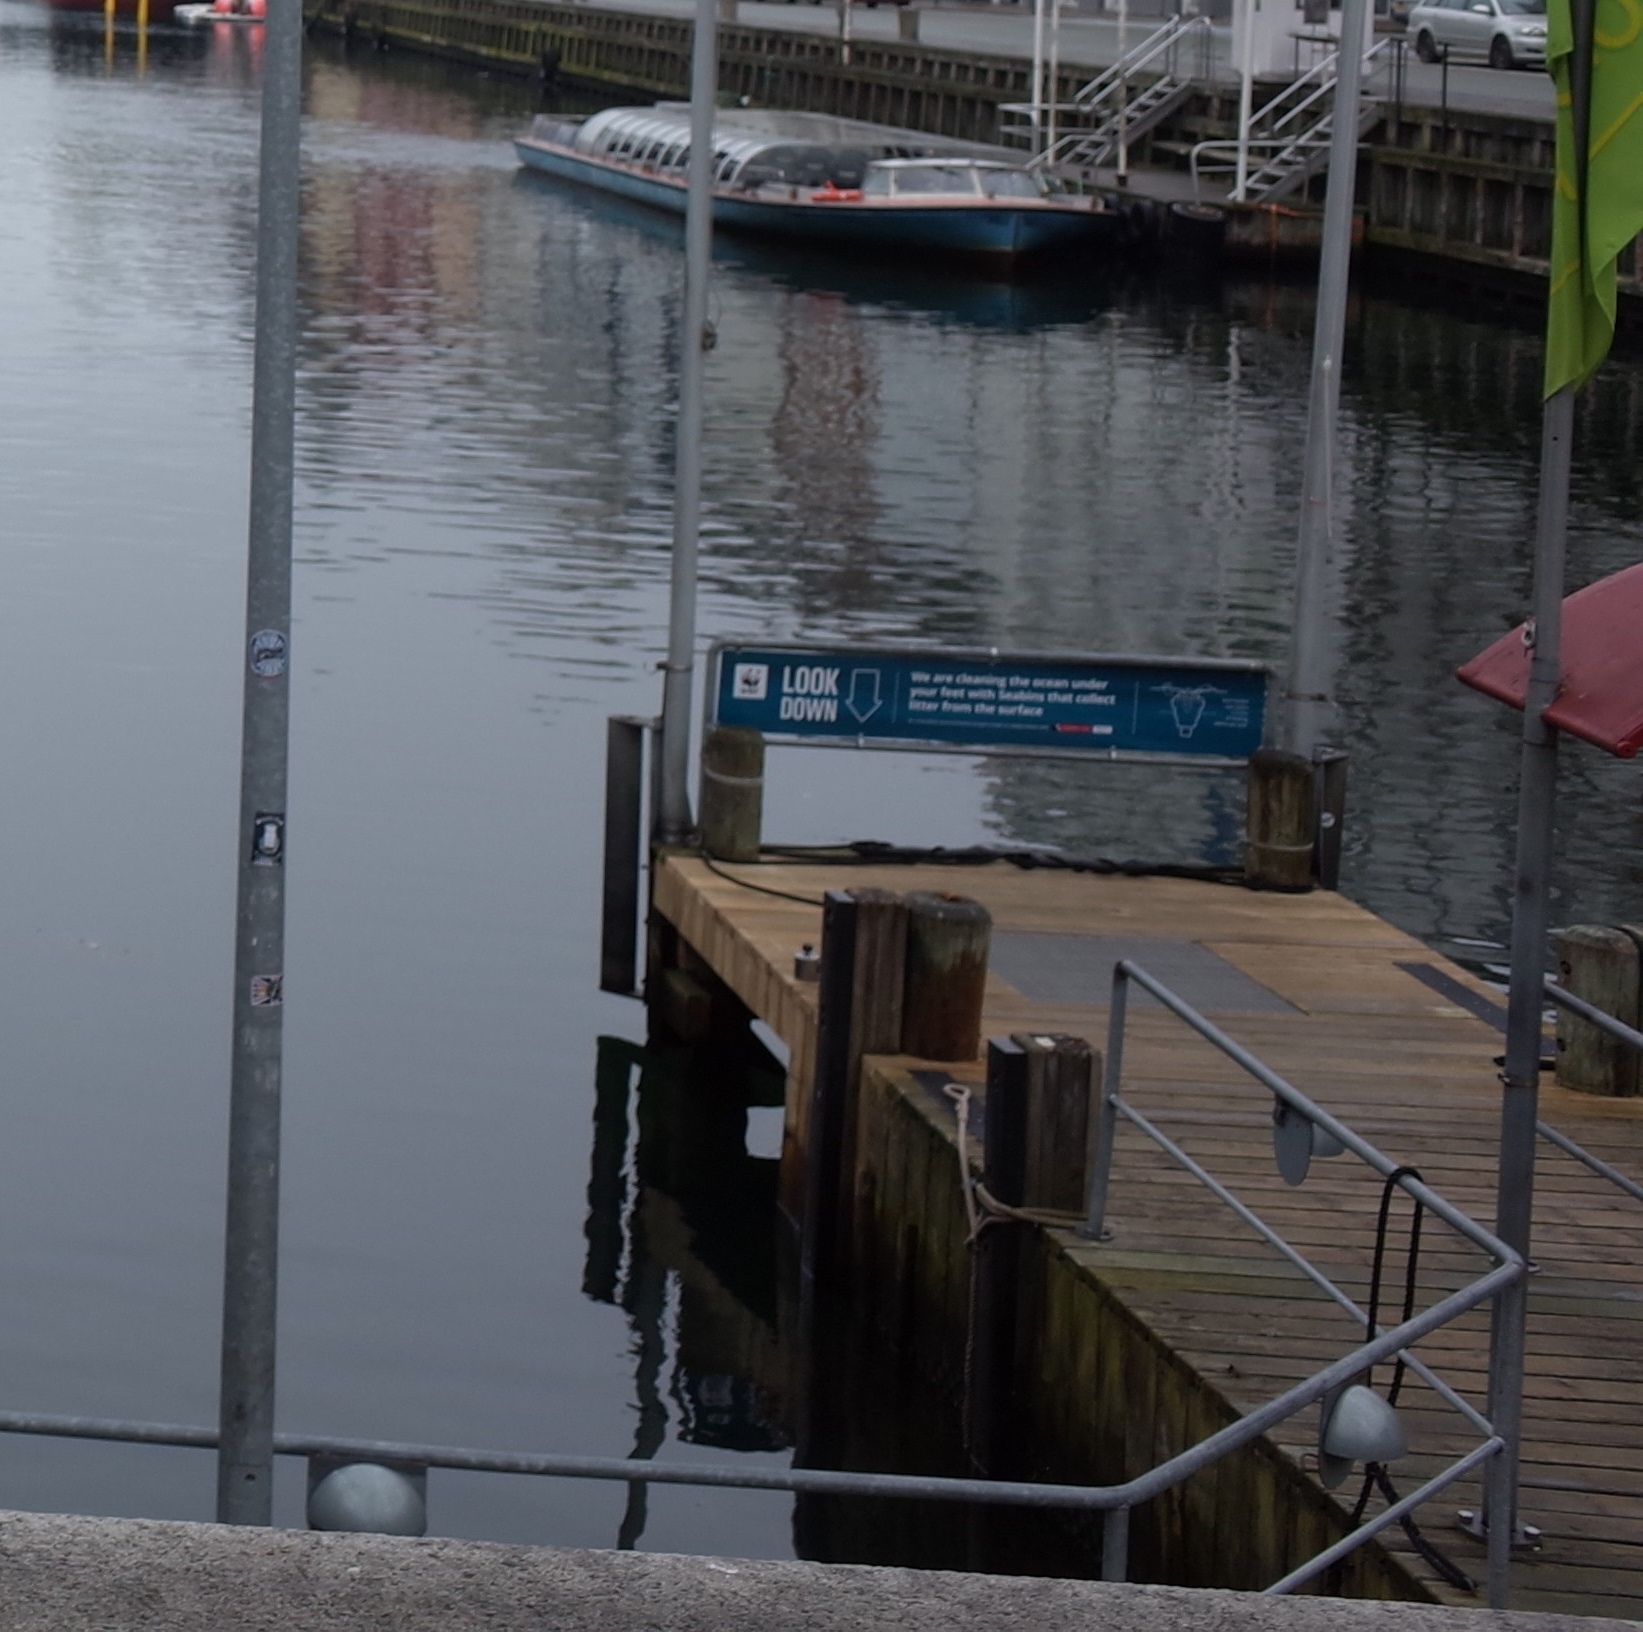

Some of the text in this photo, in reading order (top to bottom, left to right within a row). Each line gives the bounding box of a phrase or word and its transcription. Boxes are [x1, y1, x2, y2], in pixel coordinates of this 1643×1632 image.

[782, 665, 841, 696] LOOK
[911, 671, 1108, 691] We are cleaning the ocean under
[910, 686, 1116, 705] your feet with Seabins that collect
[779, 697, 839, 723] DOWN
[908, 699, 1044, 717] litter from the surface
